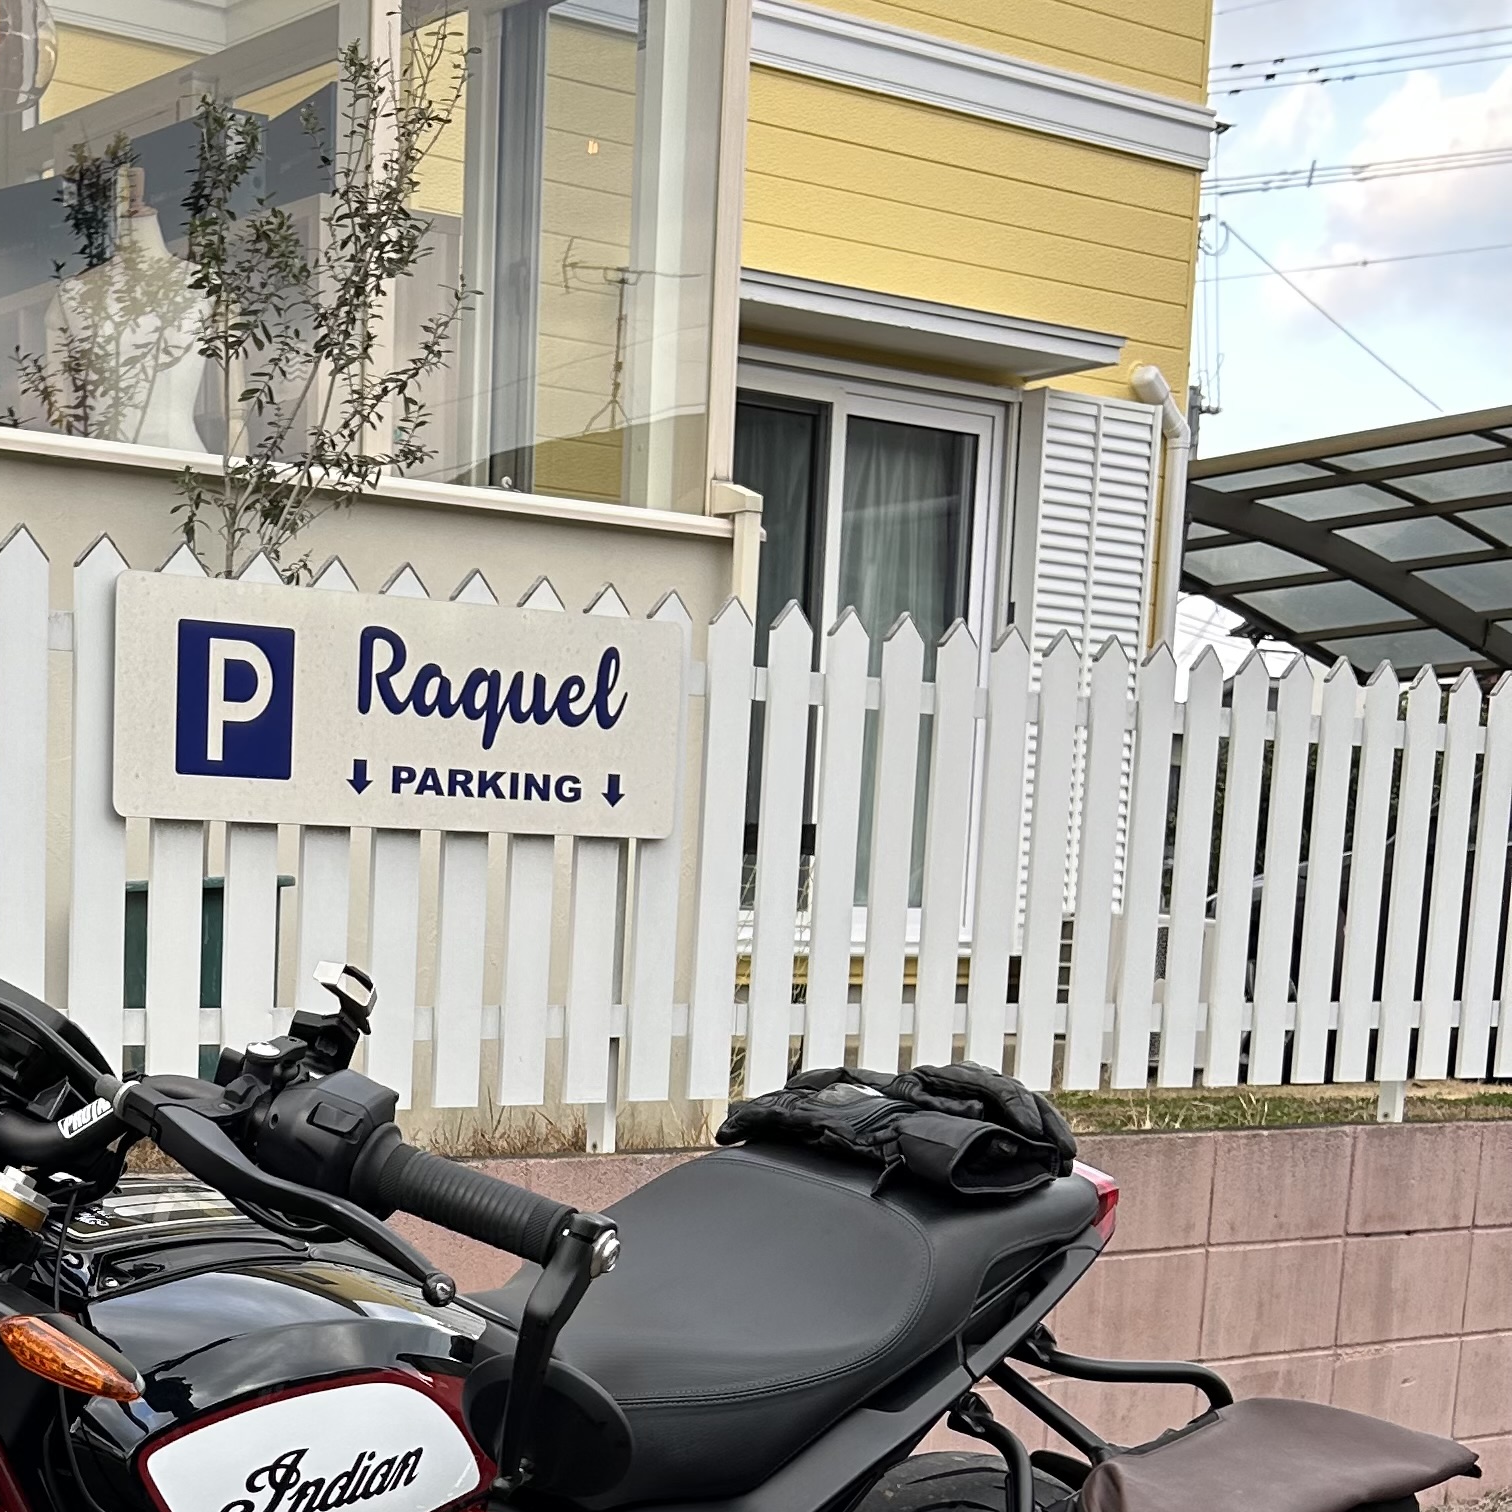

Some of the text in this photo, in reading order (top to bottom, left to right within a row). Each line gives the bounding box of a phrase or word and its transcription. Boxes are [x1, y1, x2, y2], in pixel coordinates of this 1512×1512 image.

[206, 637, 274, 762] P
[357, 625, 628, 750] Raquel
[391, 765, 583, 804] PARKING
